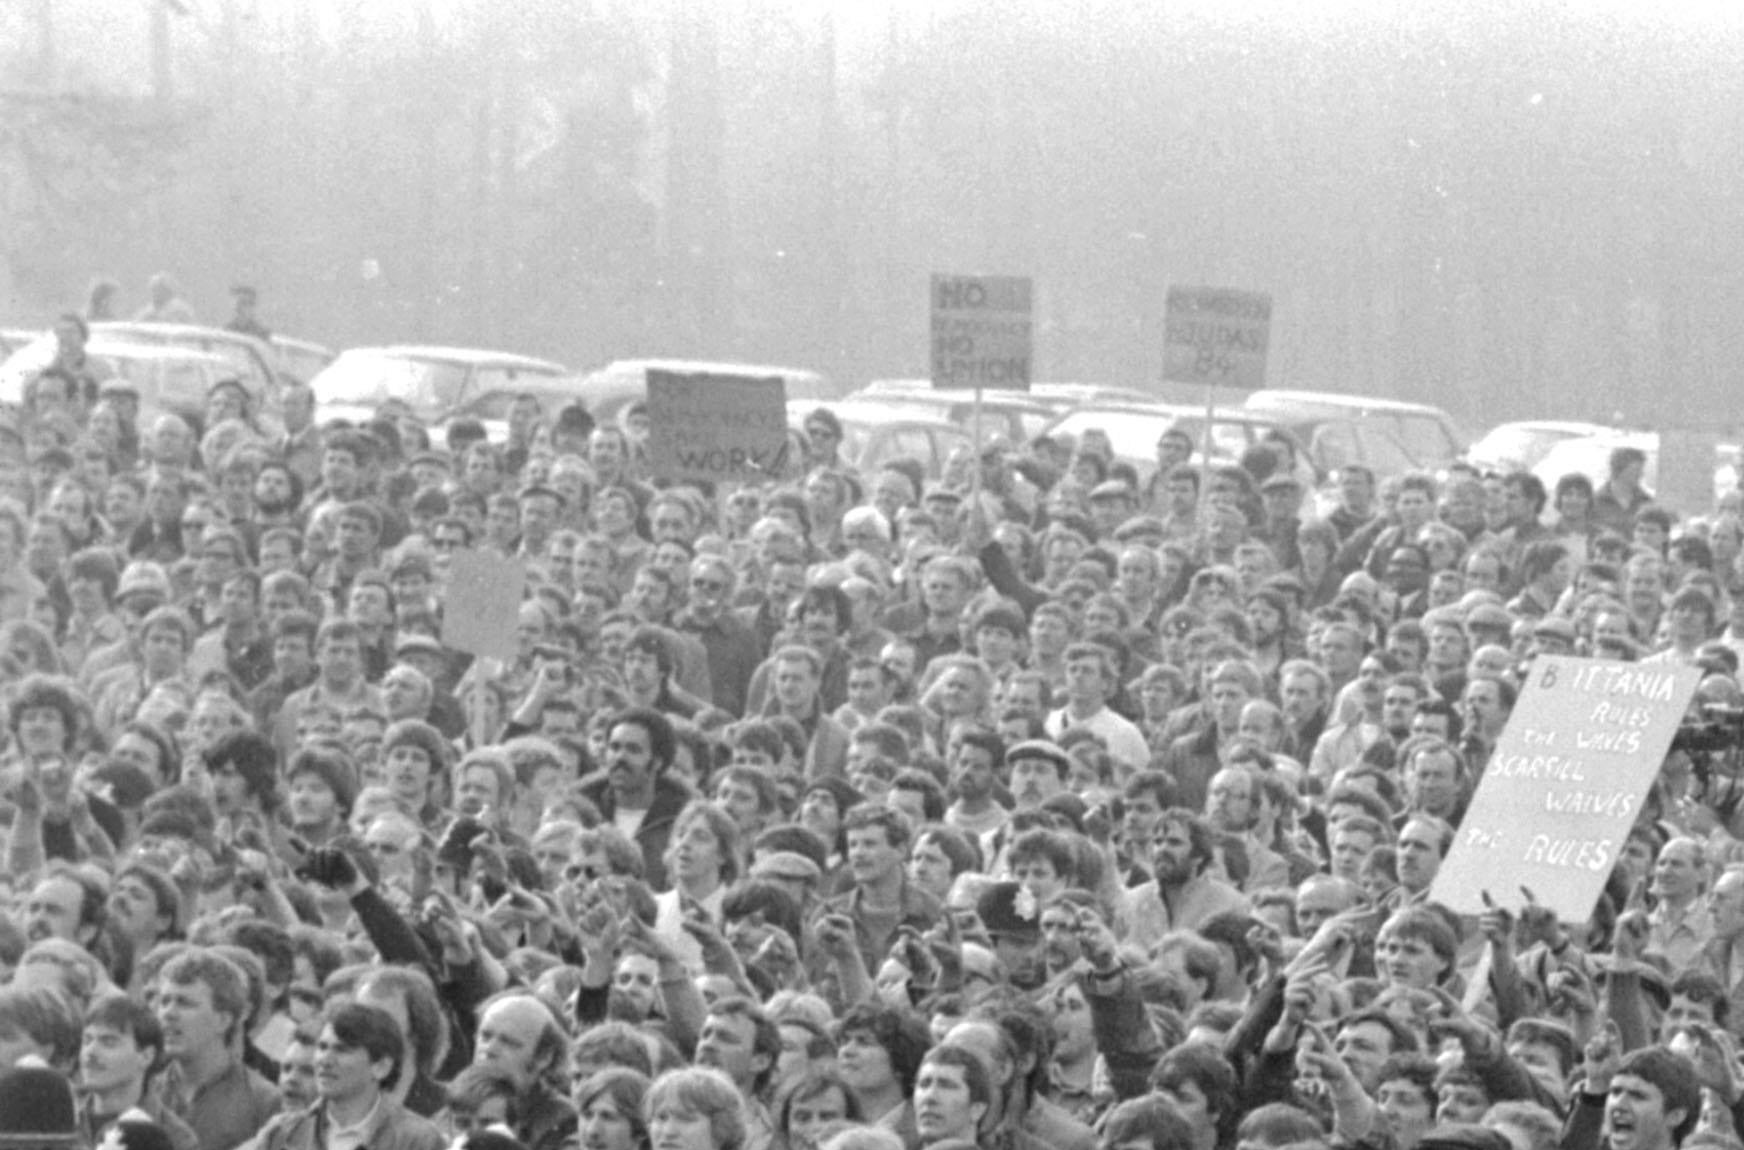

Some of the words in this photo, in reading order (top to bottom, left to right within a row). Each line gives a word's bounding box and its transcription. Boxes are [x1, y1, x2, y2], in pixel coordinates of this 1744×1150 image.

[939, 281, 987, 309] NO
[1589, 701, 1650, 727] RULES
[1546, 791, 1635, 818] WAIVES
[1524, 834, 1611, 871] RULES
